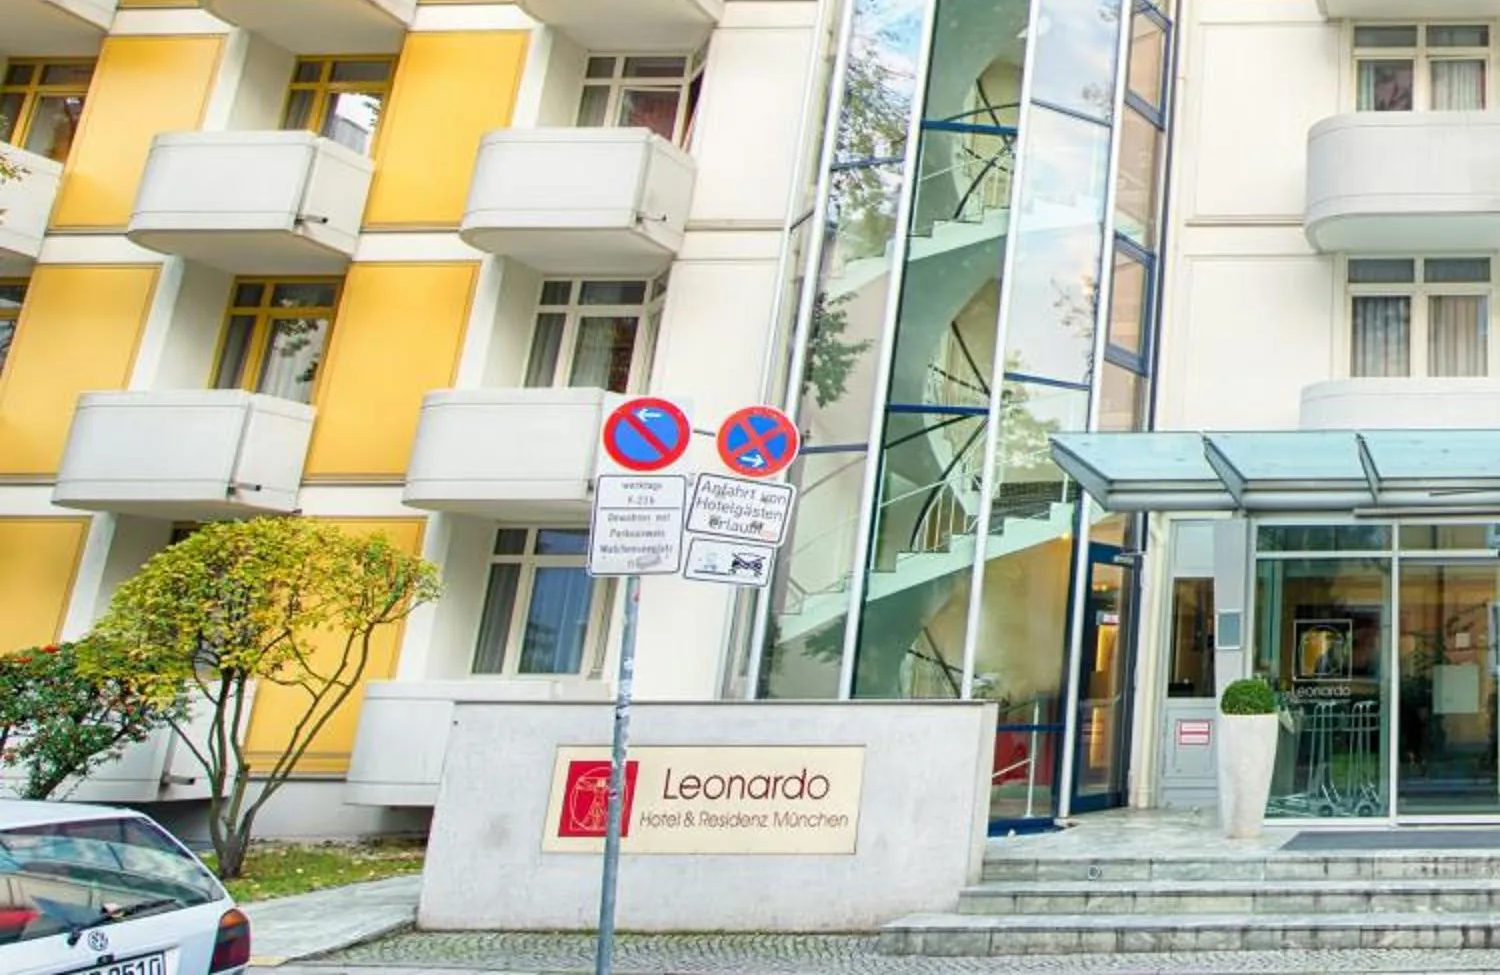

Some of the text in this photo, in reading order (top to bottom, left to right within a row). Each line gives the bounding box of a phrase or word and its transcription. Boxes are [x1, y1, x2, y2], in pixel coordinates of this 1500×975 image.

[696, 496, 783, 521] Hotelgästen
[1291, 682, 1351, 699] Leonardo
[662, 768, 830, 800] Leonardo
[639, 810, 849, 828] Hotel & Residenz München
